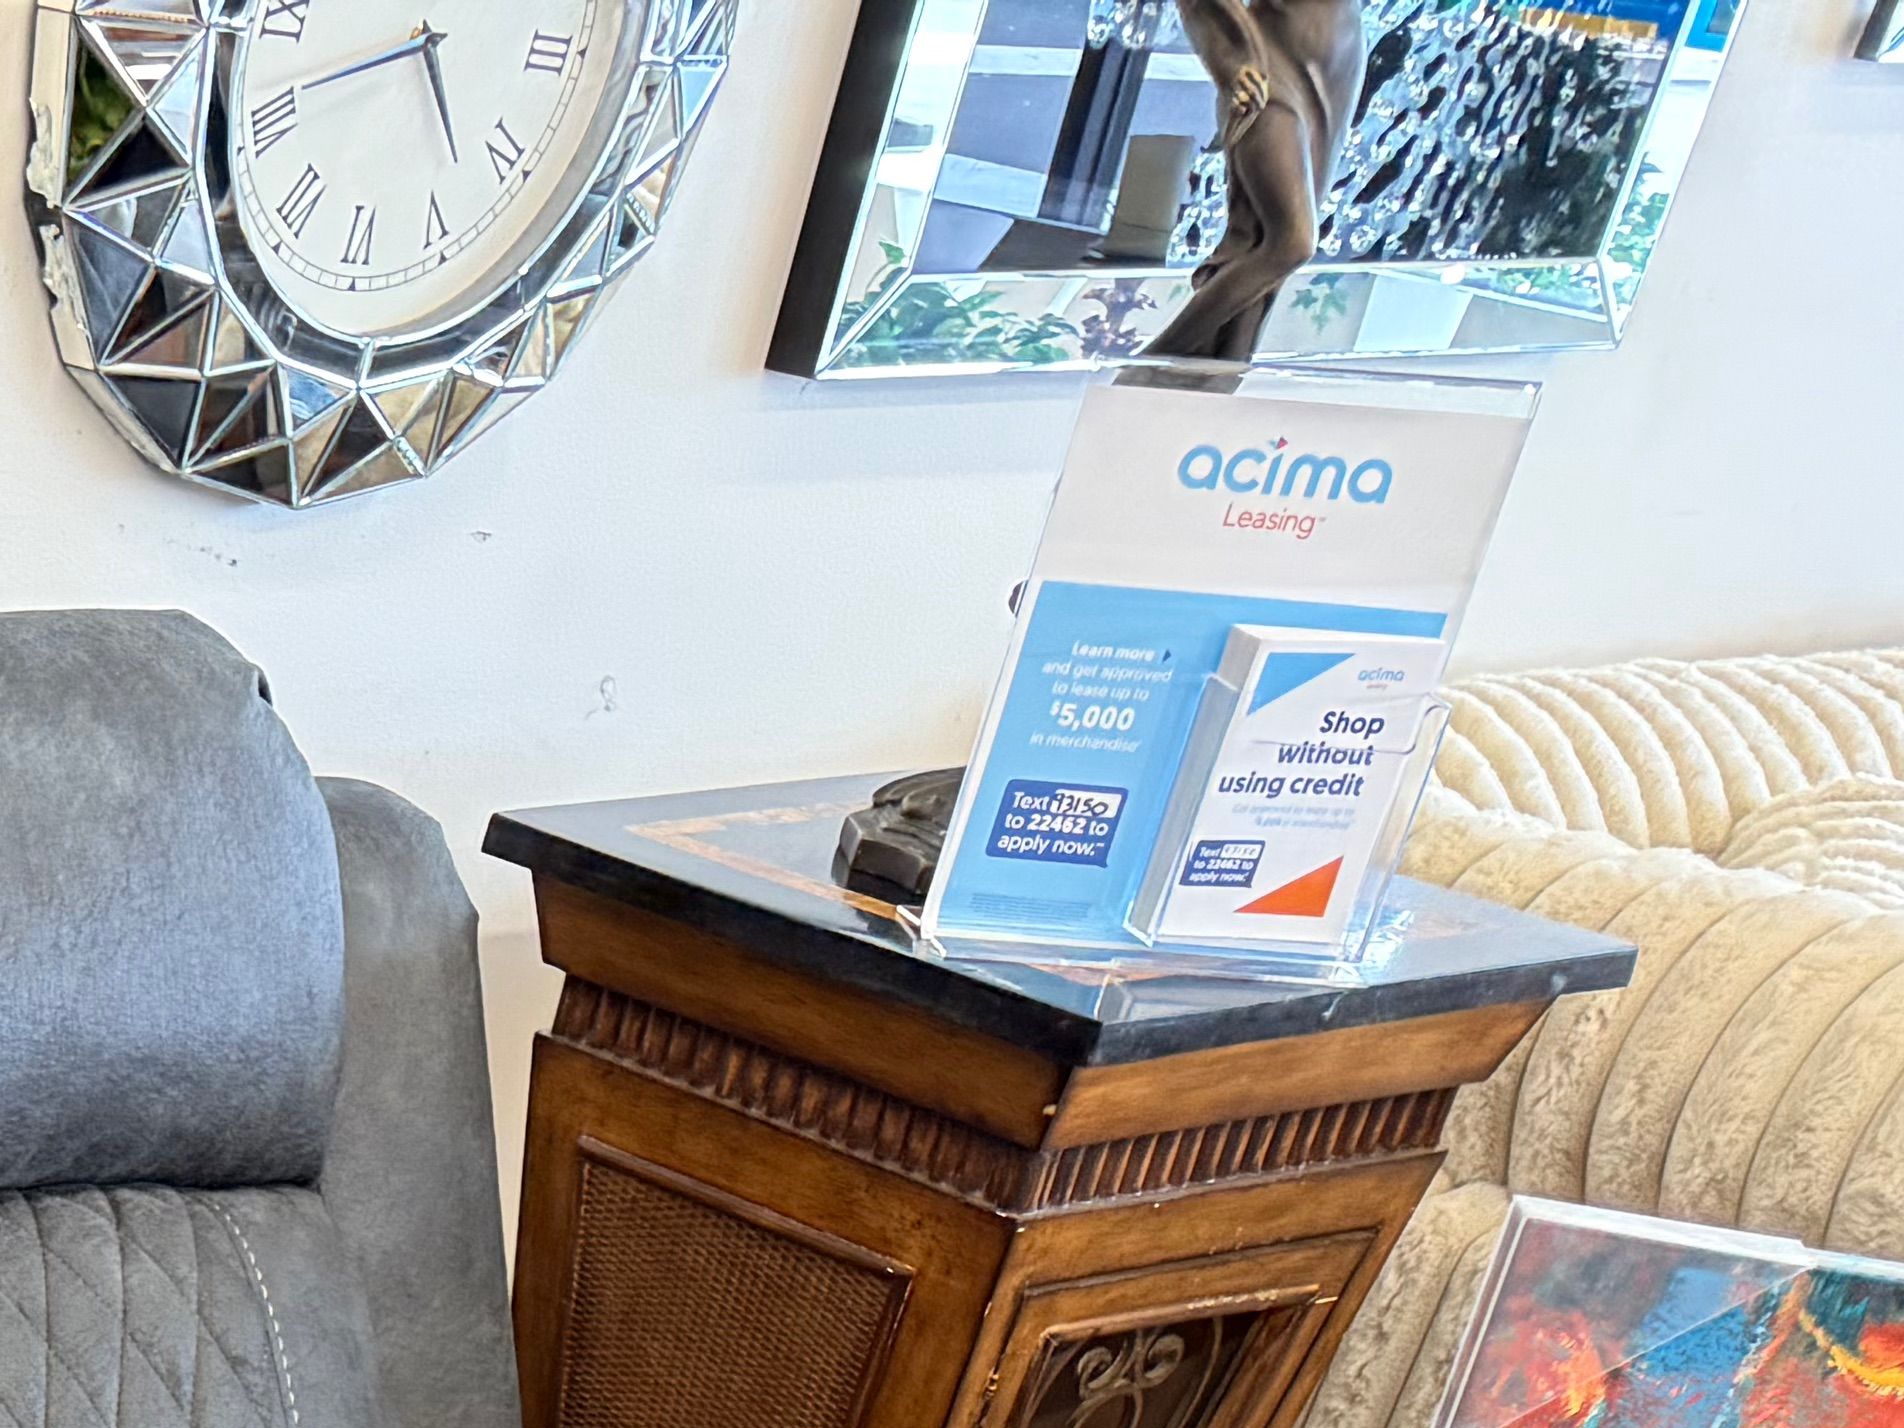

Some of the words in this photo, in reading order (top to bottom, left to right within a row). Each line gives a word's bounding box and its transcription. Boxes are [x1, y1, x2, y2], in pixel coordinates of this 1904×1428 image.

[523, 29, 573, 76] III
[251, 86, 298, 158] VIII
[485, 117, 526, 184] IV
[276, 163, 327, 239] VII
[423, 190, 449, 249] V
[340, 205, 376, 264] VI
[1178, 437, 1393, 504] acima
[1071, 640, 1113, 658] Learn
[1114, 647, 1156, 661] more
[1043, 661, 1072, 676] and
[1073, 665, 1098, 679] get
[1100, 665, 1174, 682] approved
[1358, 667, 1405, 682] acima
[1052, 681, 1068, 694] to
[1071, 682, 1109, 697] lease
[1110, 689, 1130, 702] up
[1132, 688, 1150, 701] to
[1050, 701, 1135, 731] $5,000
[1320, 711, 1385, 739] Shop
[1029, 732, 1045, 745] in
[1277, 741, 1374, 766] without
[1218, 771, 1286, 798] using
[1289, 773, 1364, 796] credit
[1012, 792, 1049, 810] Text
[1004, 813, 1025, 829] to
[1026, 813, 1087, 834] 22462
[1089, 820, 1109, 836] to
[997, 835, 1050, 855] apply
[1199, 846, 1221, 858] Text
